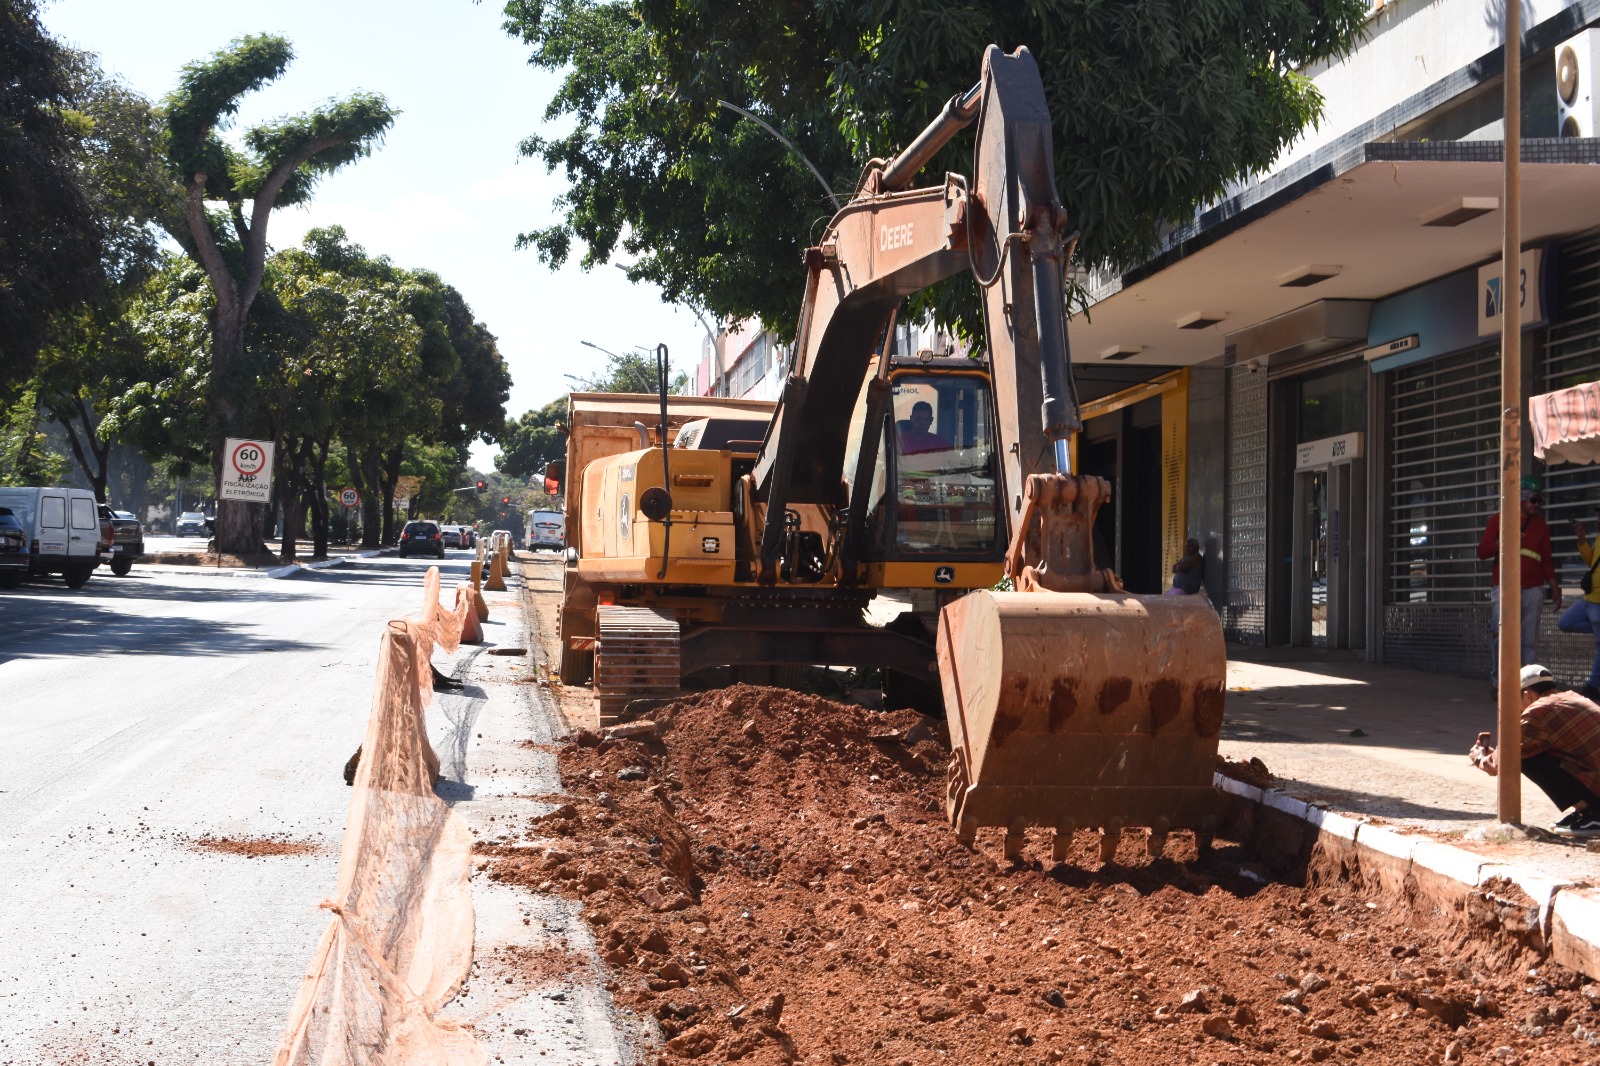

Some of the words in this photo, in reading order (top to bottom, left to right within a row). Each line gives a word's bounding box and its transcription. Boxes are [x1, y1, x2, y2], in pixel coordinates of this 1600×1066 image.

[880, 222, 914, 251] DEERE
[240, 449, 258, 461] 60
[224, 481, 268, 490] FISCALIZAÇÃO
[226, 489, 265, 497] ELETRÔNICA
